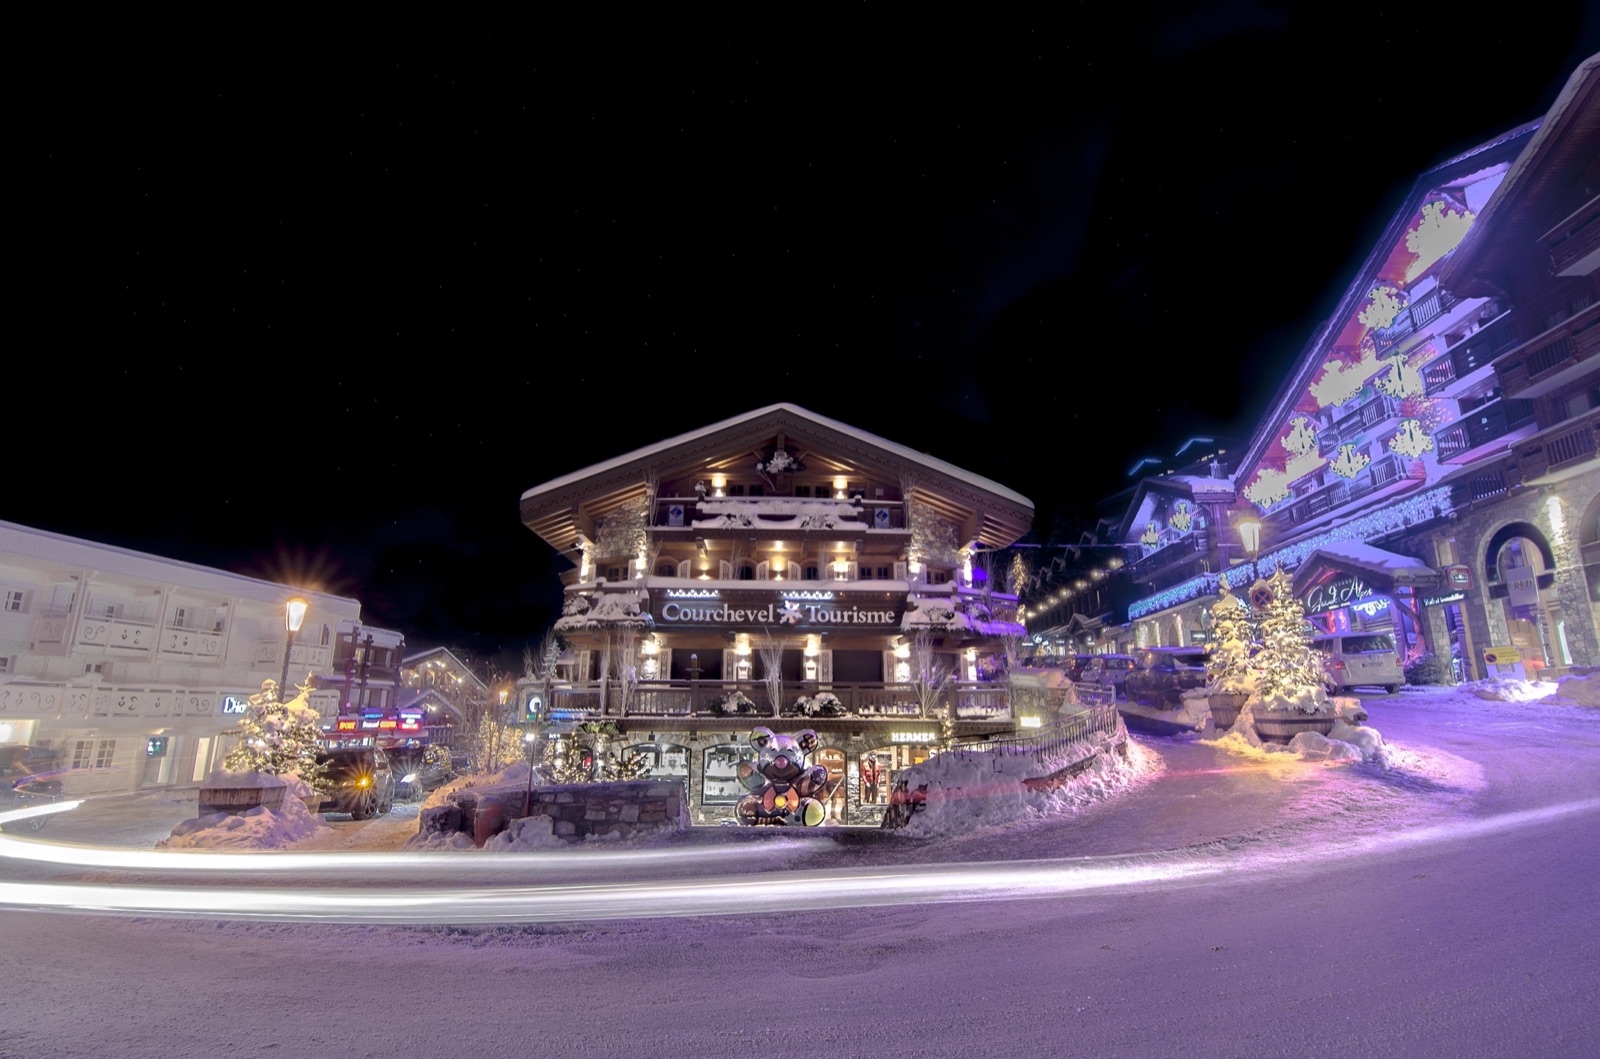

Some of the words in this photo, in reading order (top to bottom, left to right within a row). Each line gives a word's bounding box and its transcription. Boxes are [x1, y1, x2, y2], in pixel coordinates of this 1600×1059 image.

[662, 603, 774, 624] Courchevel
[805, 603, 895, 624] Tourisme
[223, 696, 247, 714] Dio
